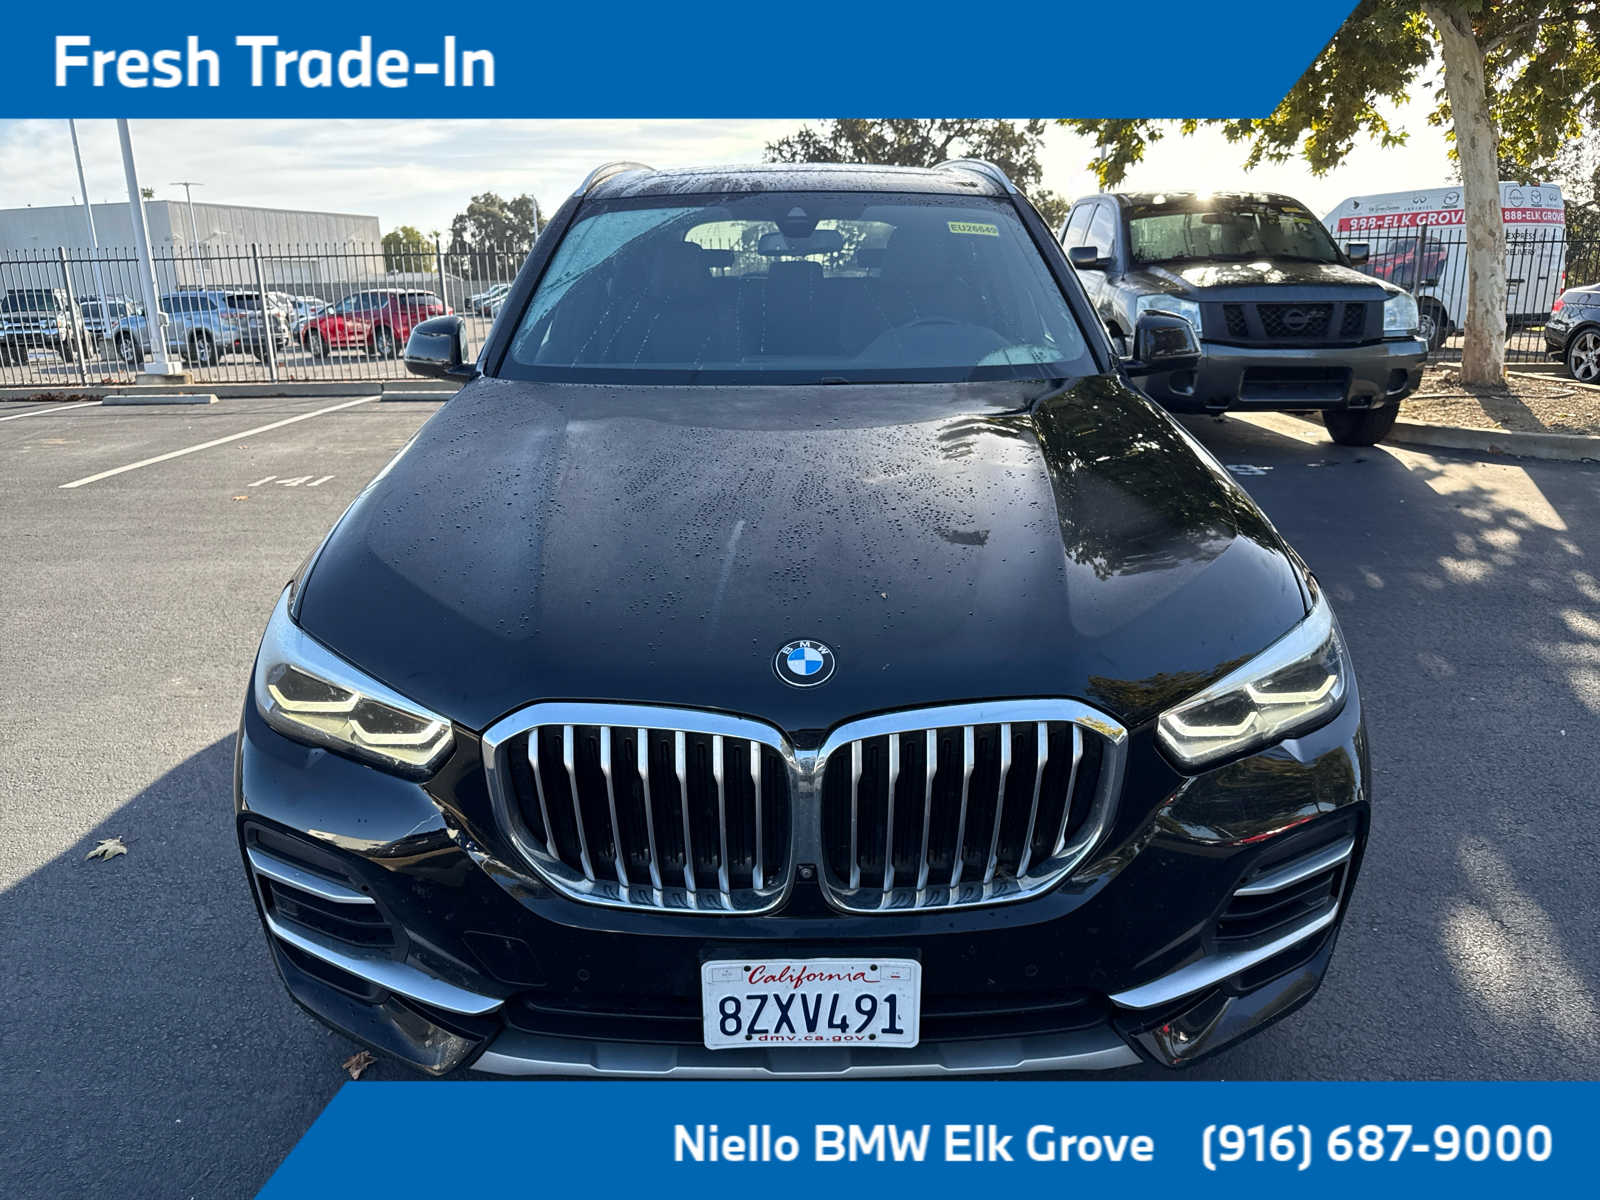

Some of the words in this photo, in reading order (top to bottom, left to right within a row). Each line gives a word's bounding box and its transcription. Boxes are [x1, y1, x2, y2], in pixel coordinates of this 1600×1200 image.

[1504, 211, 1541, 221] 888-ELK
[781, 640, 829, 655] BMW
[748, 965, 880, 989] California
[719, 992, 904, 1036] 8ZXV491
[758, 1033, 865, 1042] dmv.ca.gov
